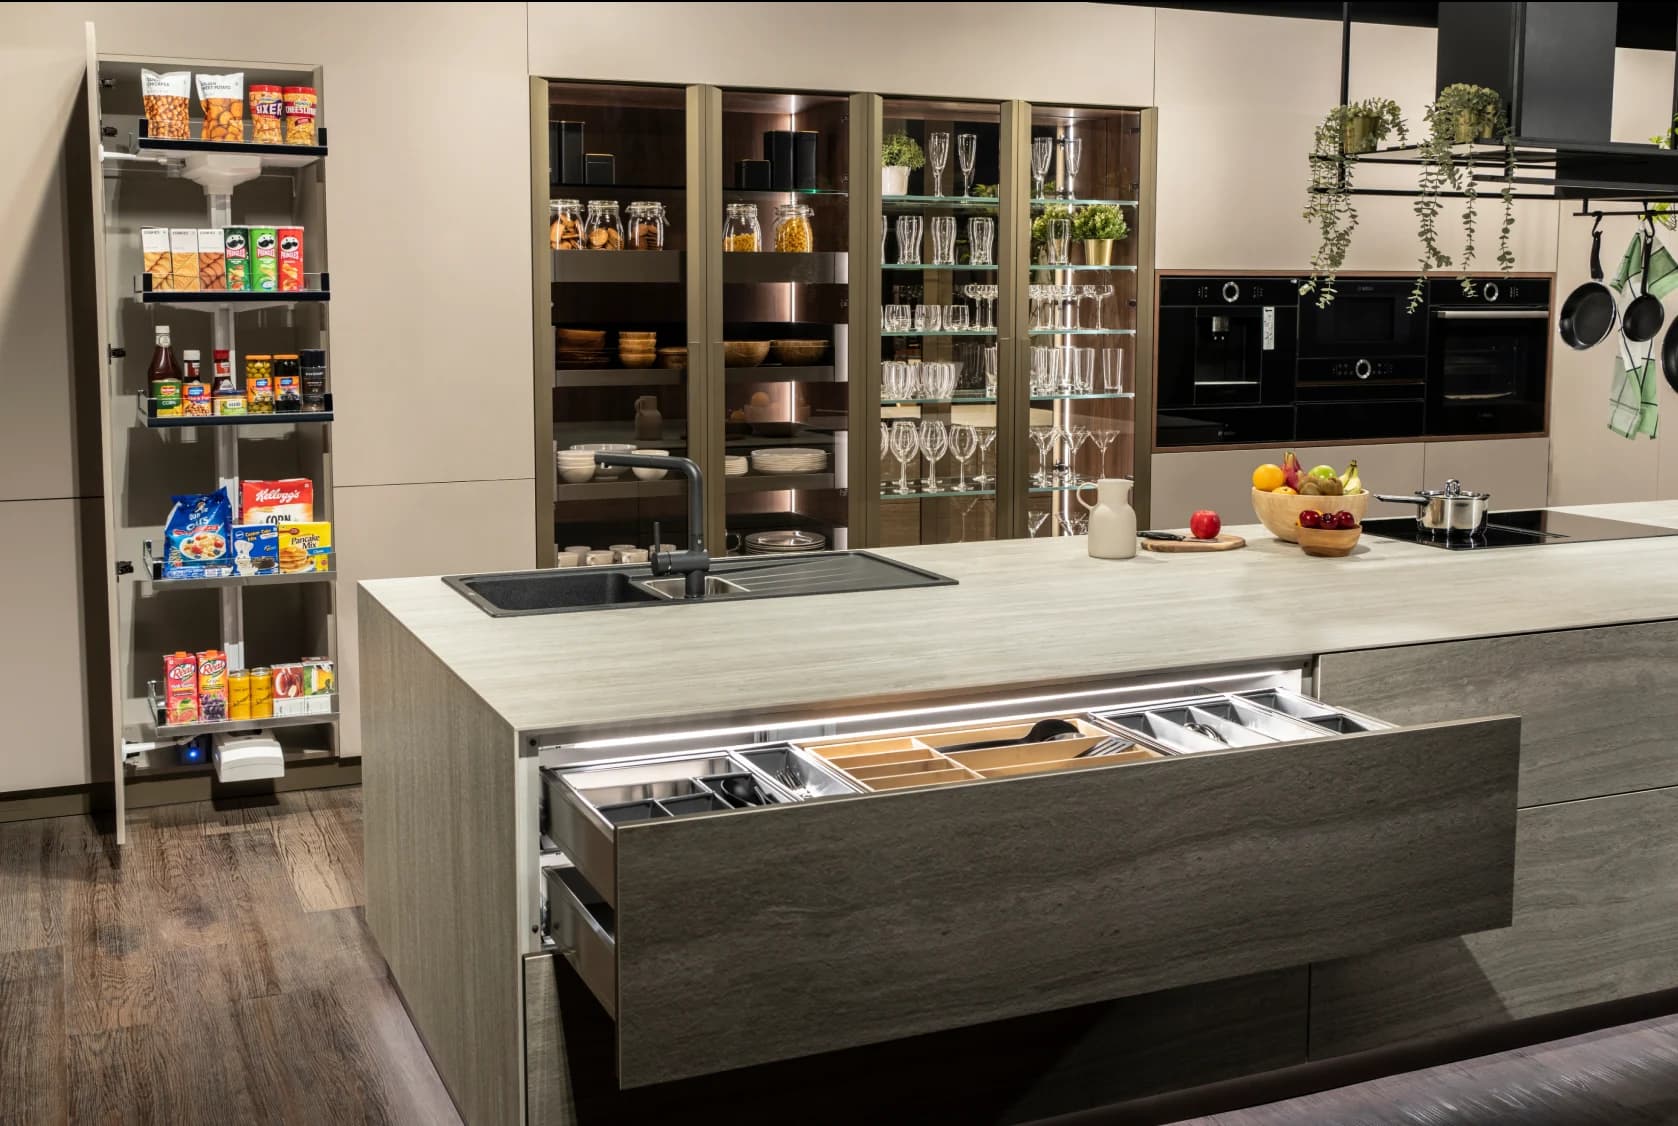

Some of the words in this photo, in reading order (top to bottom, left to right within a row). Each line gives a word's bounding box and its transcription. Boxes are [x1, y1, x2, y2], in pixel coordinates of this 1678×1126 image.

[256, 103, 282, 116] SIXER
[255, 488, 301, 503] Kellogg's
[291, 534, 320, 545] Pancake
[302, 541, 317, 550] Mix
[174, 665, 193, 679] Real
[203, 661, 224, 674] Real
